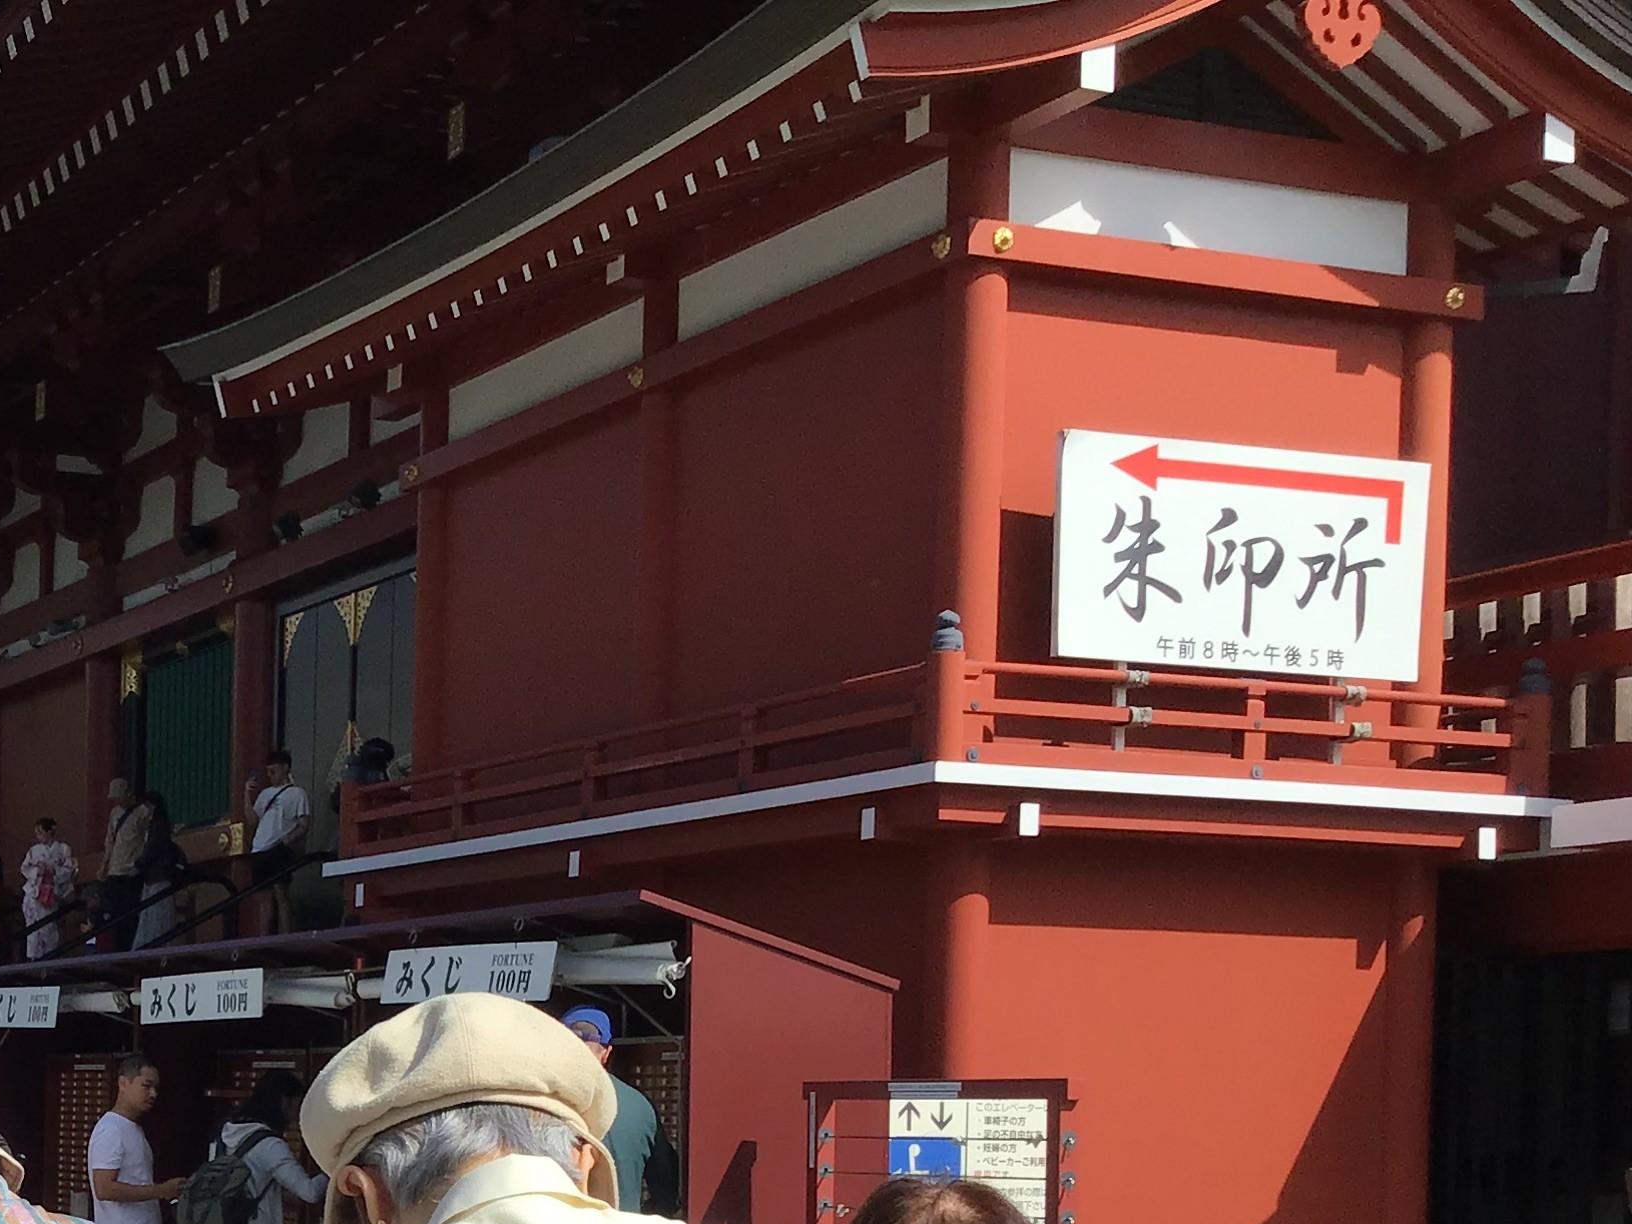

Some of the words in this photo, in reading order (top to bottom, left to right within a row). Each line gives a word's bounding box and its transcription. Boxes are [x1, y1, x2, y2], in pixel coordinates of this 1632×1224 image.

[1102, 496, 1385, 643] 朱印所
[491, 953, 535, 967] FORTUNE
[396, 956, 463, 997] みくじ
[487, 969, 532, 994] 100円
[149, 983, 197, 1018] みくじ
[217, 992, 248, 1013] 100円
